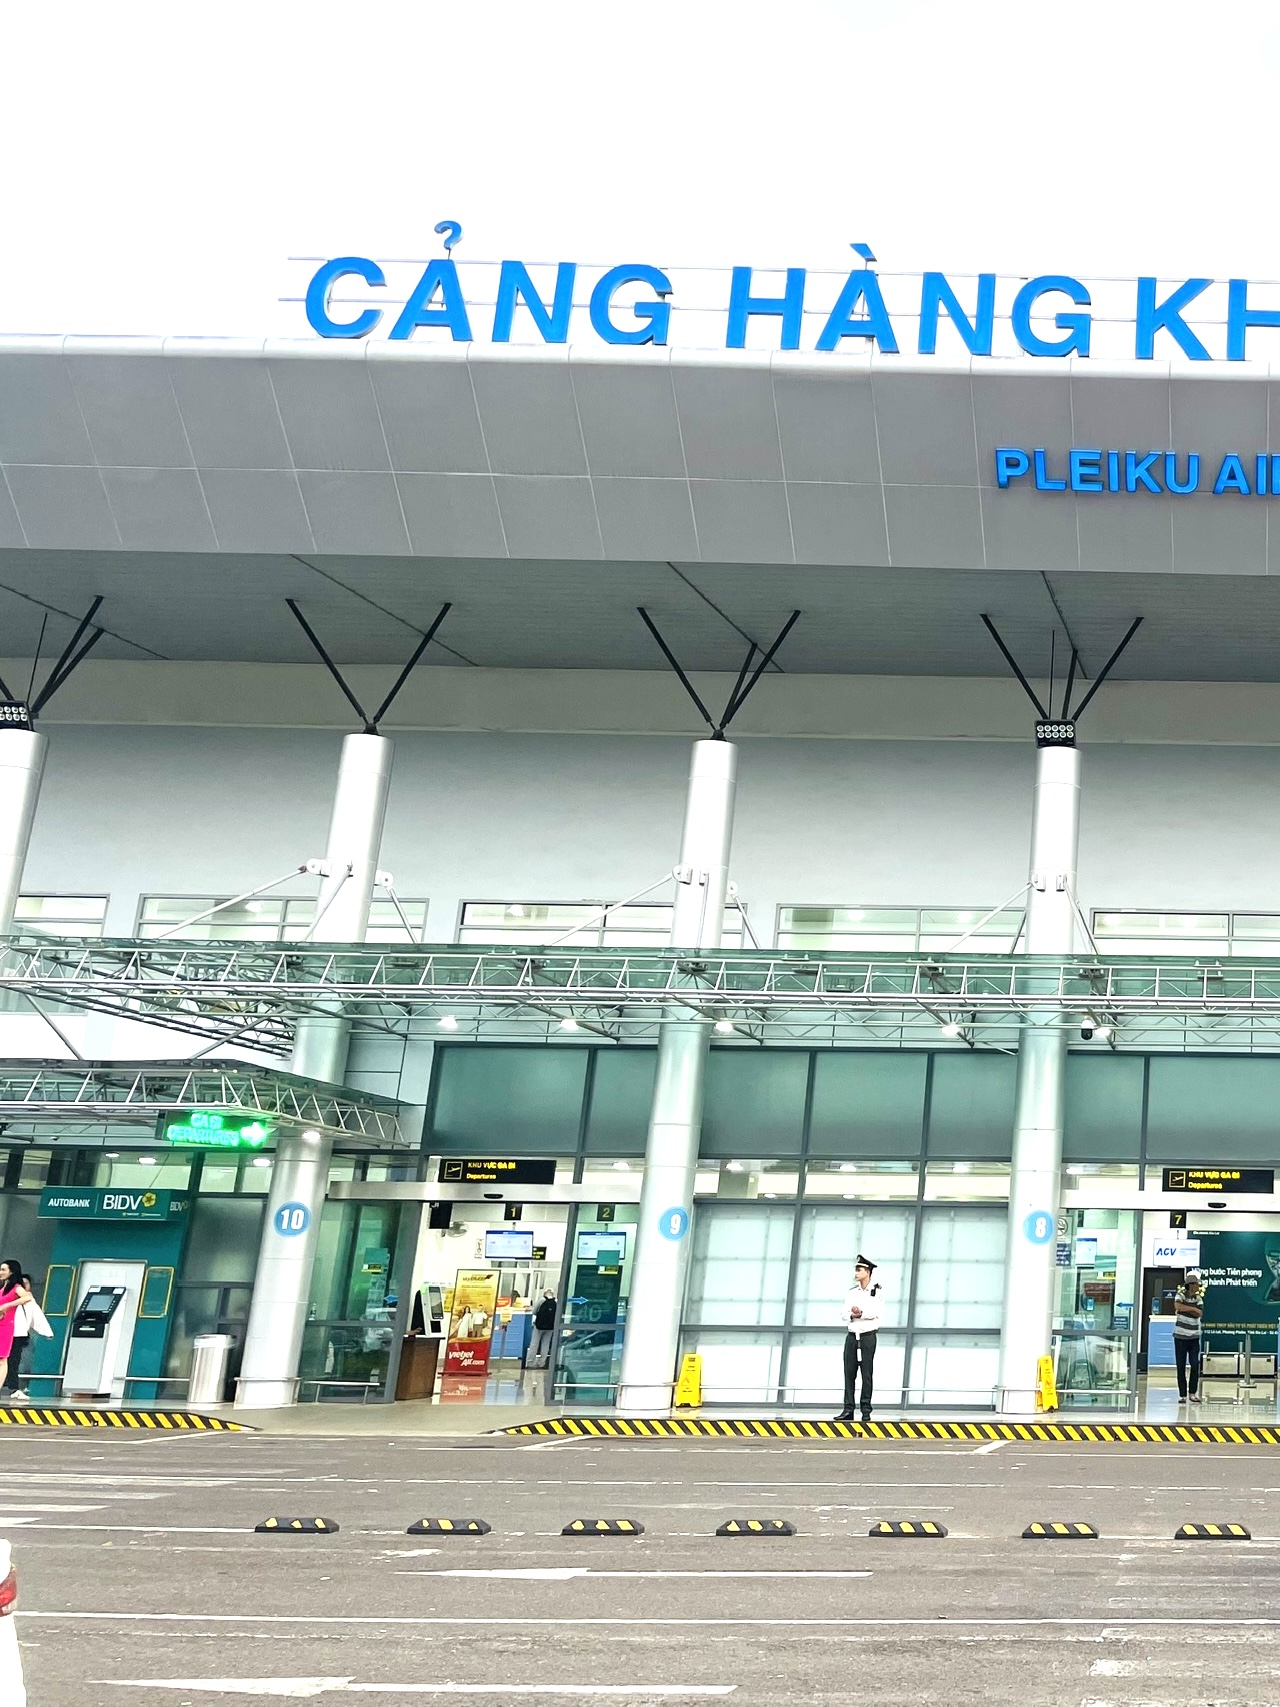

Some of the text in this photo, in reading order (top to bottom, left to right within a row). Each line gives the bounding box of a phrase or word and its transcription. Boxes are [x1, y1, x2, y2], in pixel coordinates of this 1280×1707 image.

[304, 221, 673, 345] CẢNG
[725, 244, 1092, 358] HÀNG
[995, 448, 1200, 497] PLEIKU
[167, 1124, 240, 1147] DEPARTURES
[1188, 1182, 1223, 1190] Departures
[48, 1194, 143, 1210] AUTOBANK BIDV
[281, 1208, 305, 1230] 10
[510, 1207, 516, 1218] 1
[602, 1207, 610, 1218] 2
[1175, 1215, 1182, 1225] 7
[670, 1213, 681, 1235] 9
[1035, 1217, 1046, 1237] 8
[1156, 1247, 1177, 1256] ACV
[1241, 1268, 1262, 1278] phong
